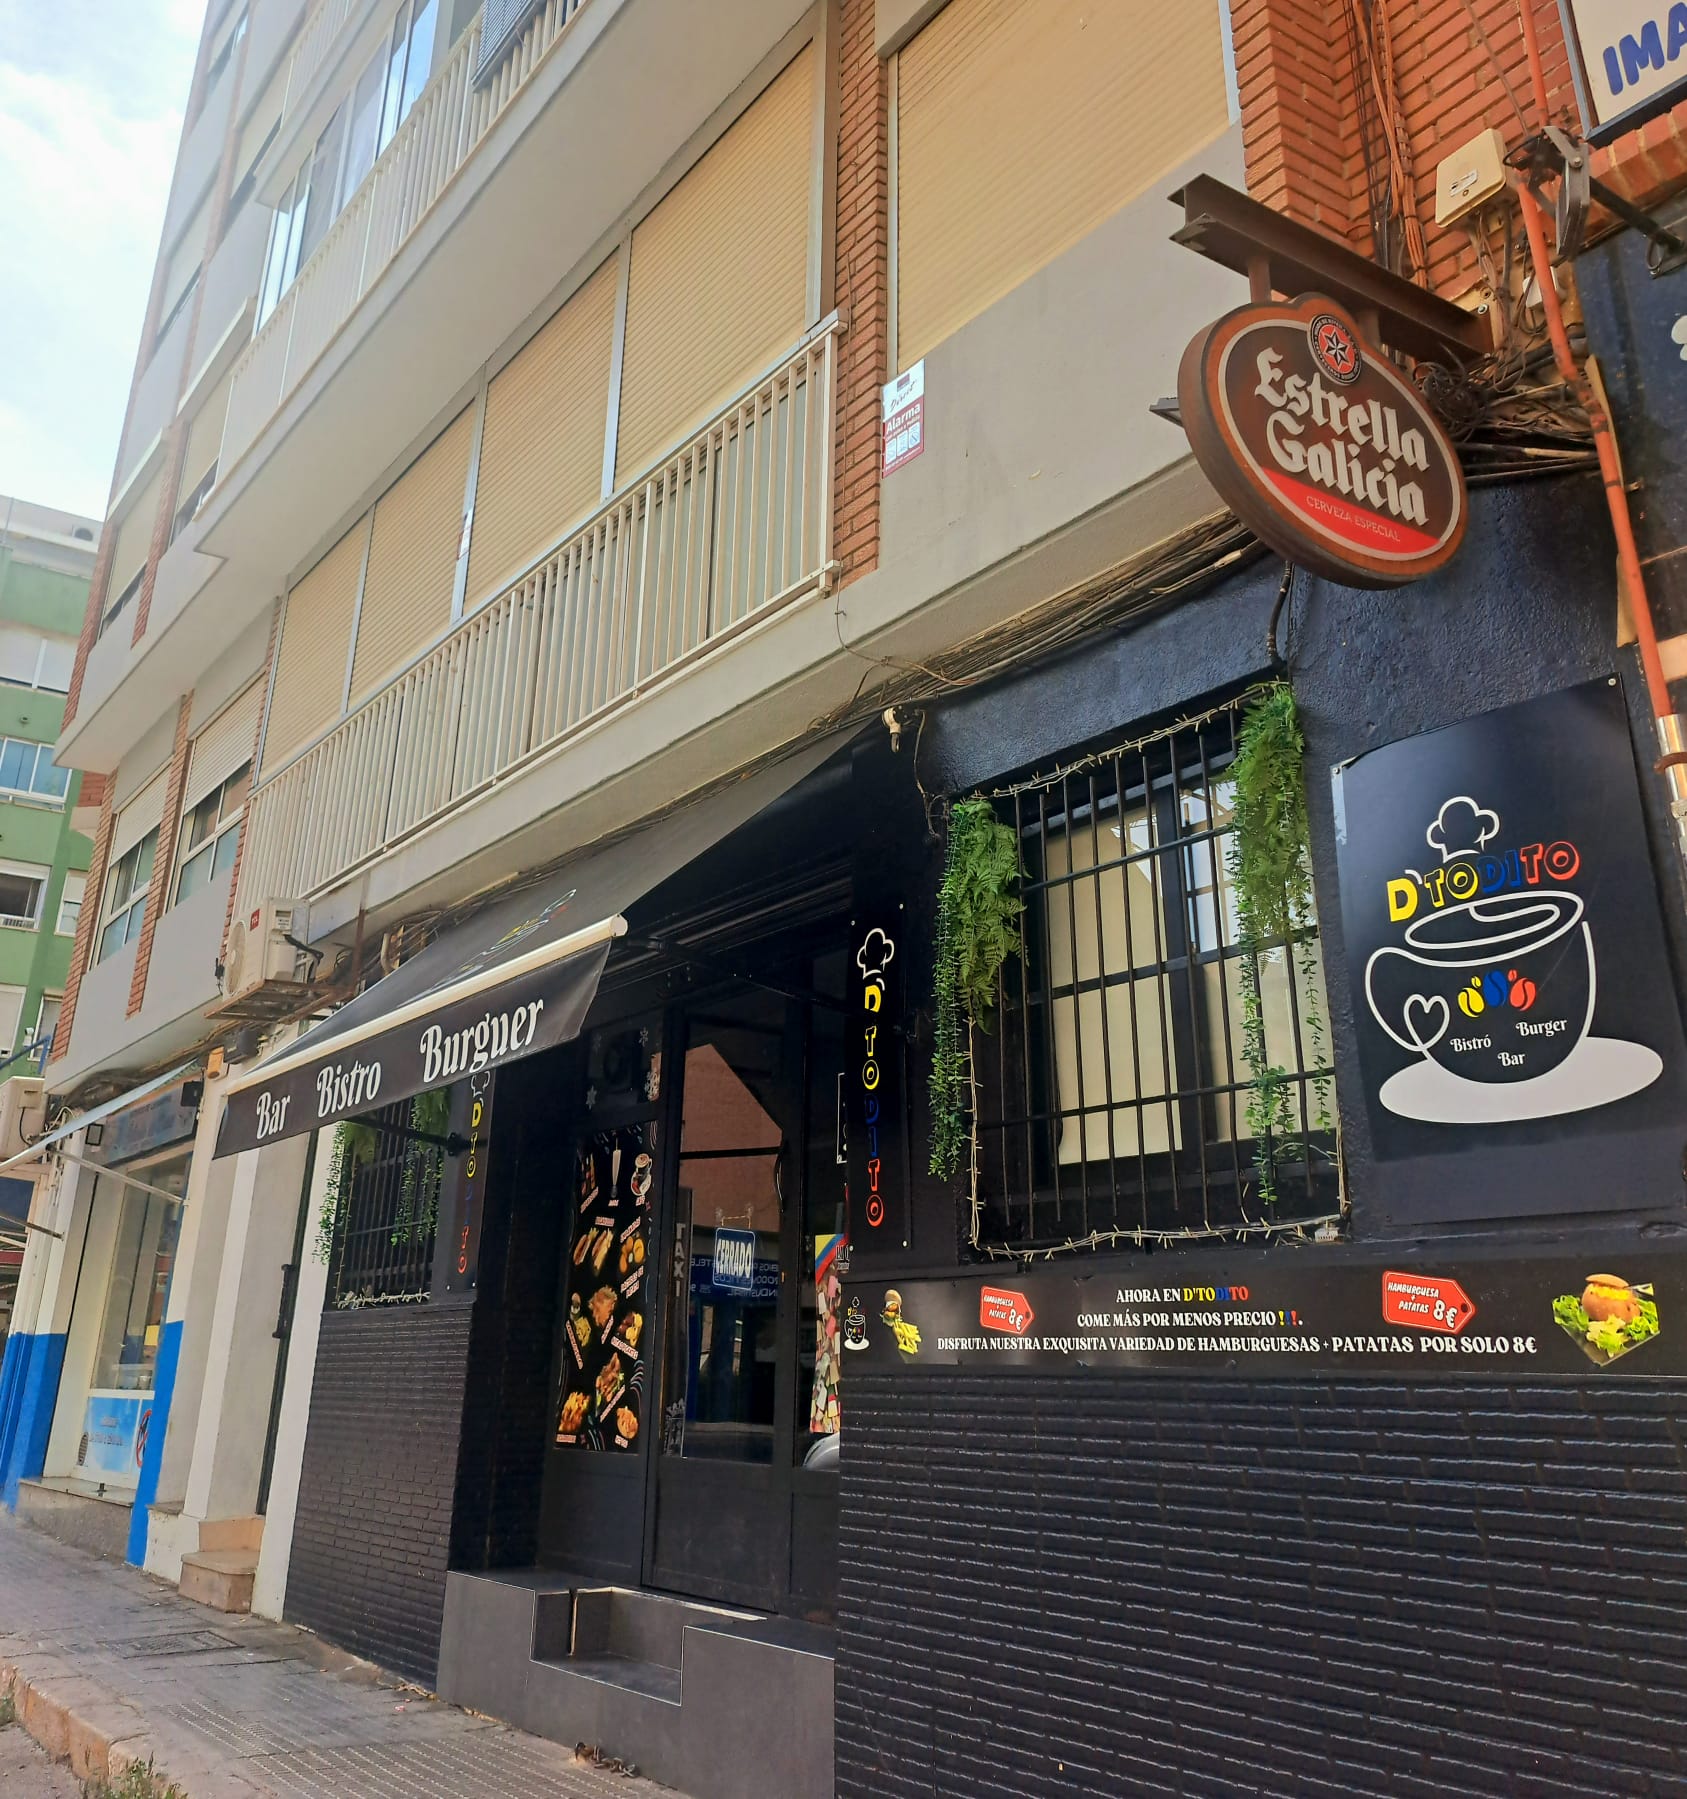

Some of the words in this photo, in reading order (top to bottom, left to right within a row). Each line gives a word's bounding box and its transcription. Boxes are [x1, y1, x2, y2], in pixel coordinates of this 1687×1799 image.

[886, 403, 921, 434] Alarma
[1254, 347, 1431, 472] Estrella
[1266, 410, 1430, 526] Galicia
[1306, 495, 1351, 522] CERVEZA
[1354, 516, 1401, 542] ESPECIAL
[1515, 1019, 1568, 1037] Burger
[1449, 1034, 1492, 1052] Bistró
[256, 1092, 291, 1140] Bar
[316, 1060, 382, 1118] Bistro
[420, 999, 544, 1083] Burguer
[1497, 1051, 1526, 1067] Bar
[716, 1239, 752, 1279] CERRADO
[1116, 1287, 1161, 1303] AHORA
[1163, 1288, 1180, 1302] EN
[1183, 1286, 1249, 1301] D'TODITO
[1387, 1281, 1440, 1298] HAMBURGUESA
[1008, 1308, 1024, 1331] 8€
[1077, 1313, 1111, 1327] COME
[1113, 1309, 1141, 1327] MÁS
[1142, 1312, 1170, 1327] POR
[1172, 1311, 1222, 1327] MENOS
[1224, 1310, 1276, 1326] PRECIO
[1398, 1300, 1430, 1314] PATATAS
[1433, 1299, 1458, 1328] 8€
[937, 1337, 988, 1350] DISFRUTA
[989, 1337, 1041, 1350] NUESTRA
[1042, 1336, 1107, 1354] EXQUISITA
[1108, 1337, 1175, 1351] VARIEDAD
[1176, 1337, 1196, 1351] DE
[1198, 1336, 1321, 1352] HAMBURGUESAS
[1331, 1336, 1414, 1353] PATATAS
[1419, 1336, 1458, 1353] POR
[1460, 1336, 1510, 1354] SOLO
[1512, 1336, 1537, 1354] 8€
